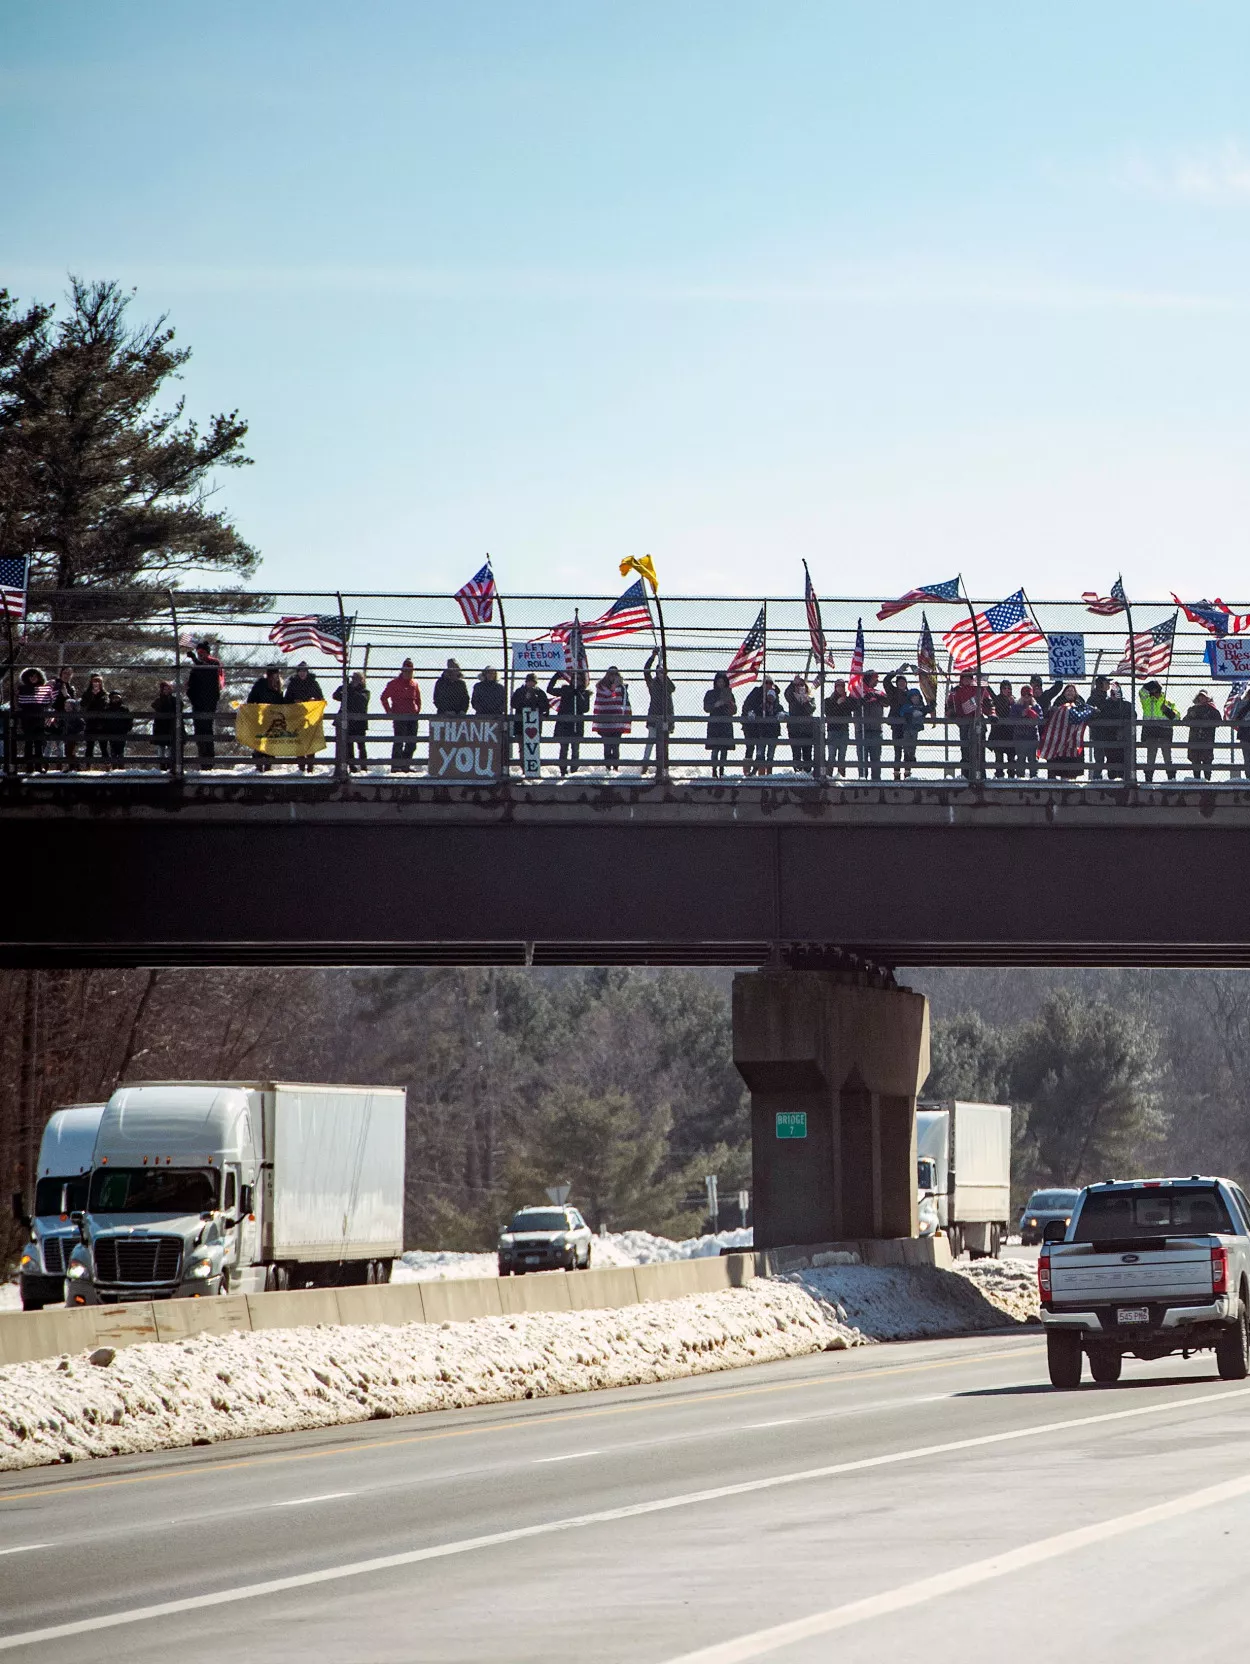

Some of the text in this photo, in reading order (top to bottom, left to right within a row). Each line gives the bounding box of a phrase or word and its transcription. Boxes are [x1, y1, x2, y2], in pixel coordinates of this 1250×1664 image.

[1048, 635, 1082, 646] We've
[1216, 640, 1243, 650] God
[525, 643, 545, 651] LET
[1052, 647, 1077, 657] Got
[1050, 657, 1079, 667] Your
[431, 721, 498, 743] THANK
[438, 747, 495, 777] YOU
[777, 1114, 805, 1125] BRIDGE
[790, 1126, 794, 1135] 7
[1119, 1312, 1133, 1321] 545
